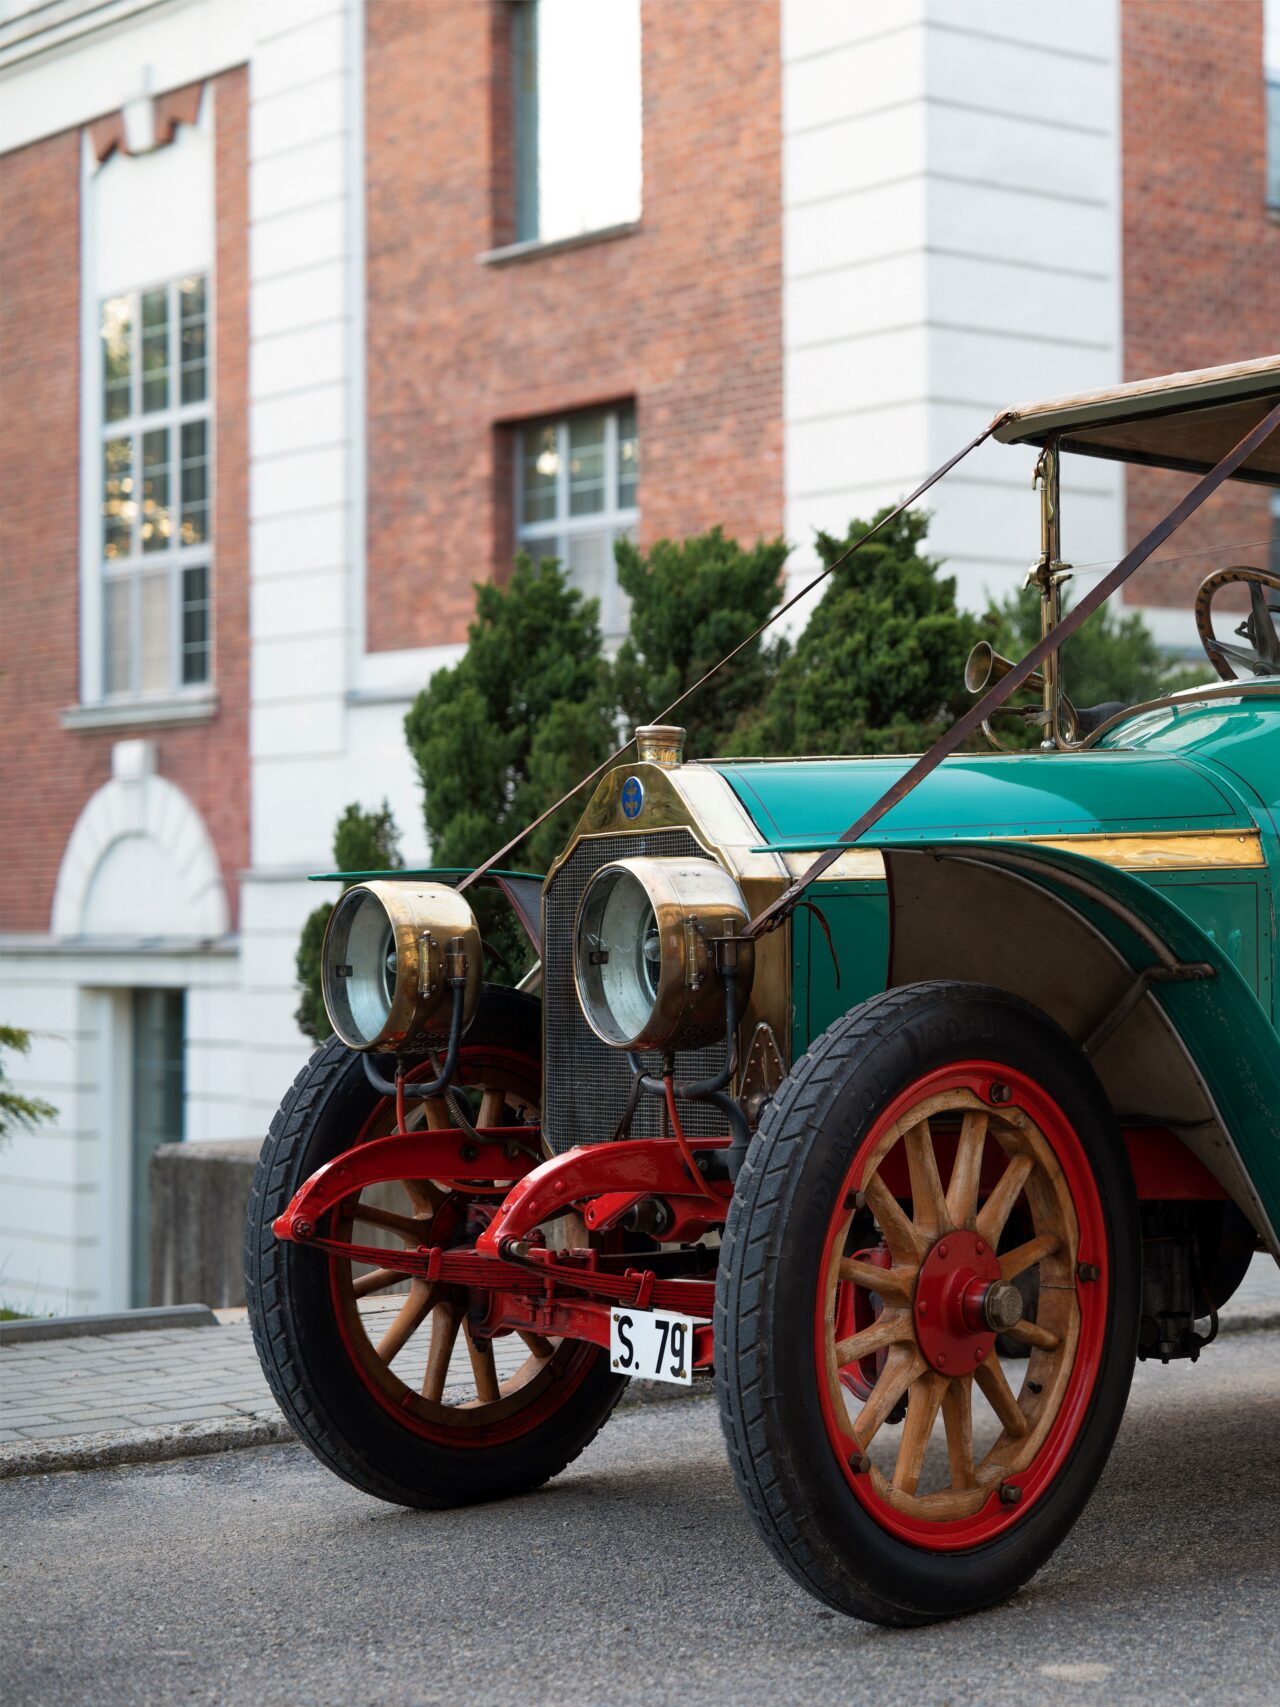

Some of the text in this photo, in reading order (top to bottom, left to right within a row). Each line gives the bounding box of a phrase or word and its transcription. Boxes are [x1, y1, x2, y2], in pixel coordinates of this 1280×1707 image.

[811, 1067, 889, 1212] DUNLOP
[618, 1316, 685, 1378] S. 79
